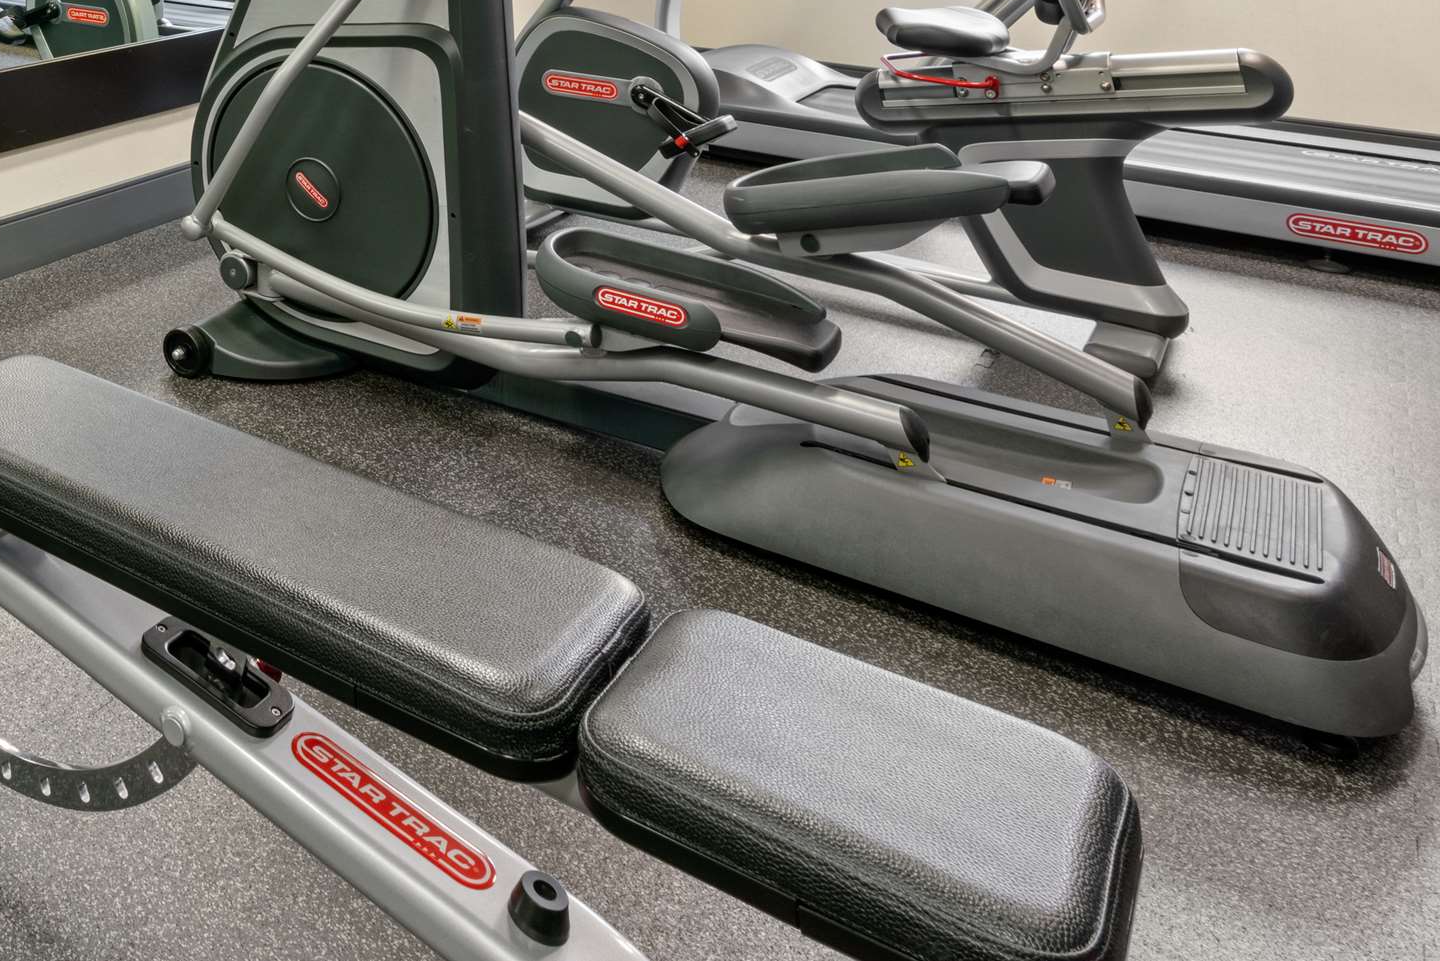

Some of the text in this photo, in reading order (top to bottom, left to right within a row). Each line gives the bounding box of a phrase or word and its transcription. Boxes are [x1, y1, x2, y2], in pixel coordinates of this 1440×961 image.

[551, 79, 611, 94] STAR TRAC
[1298, 220, 1415, 247] STAR TRAC
[604, 293, 678, 319] STAR TRAC
[308, 744, 476, 871] STAR TRAC
